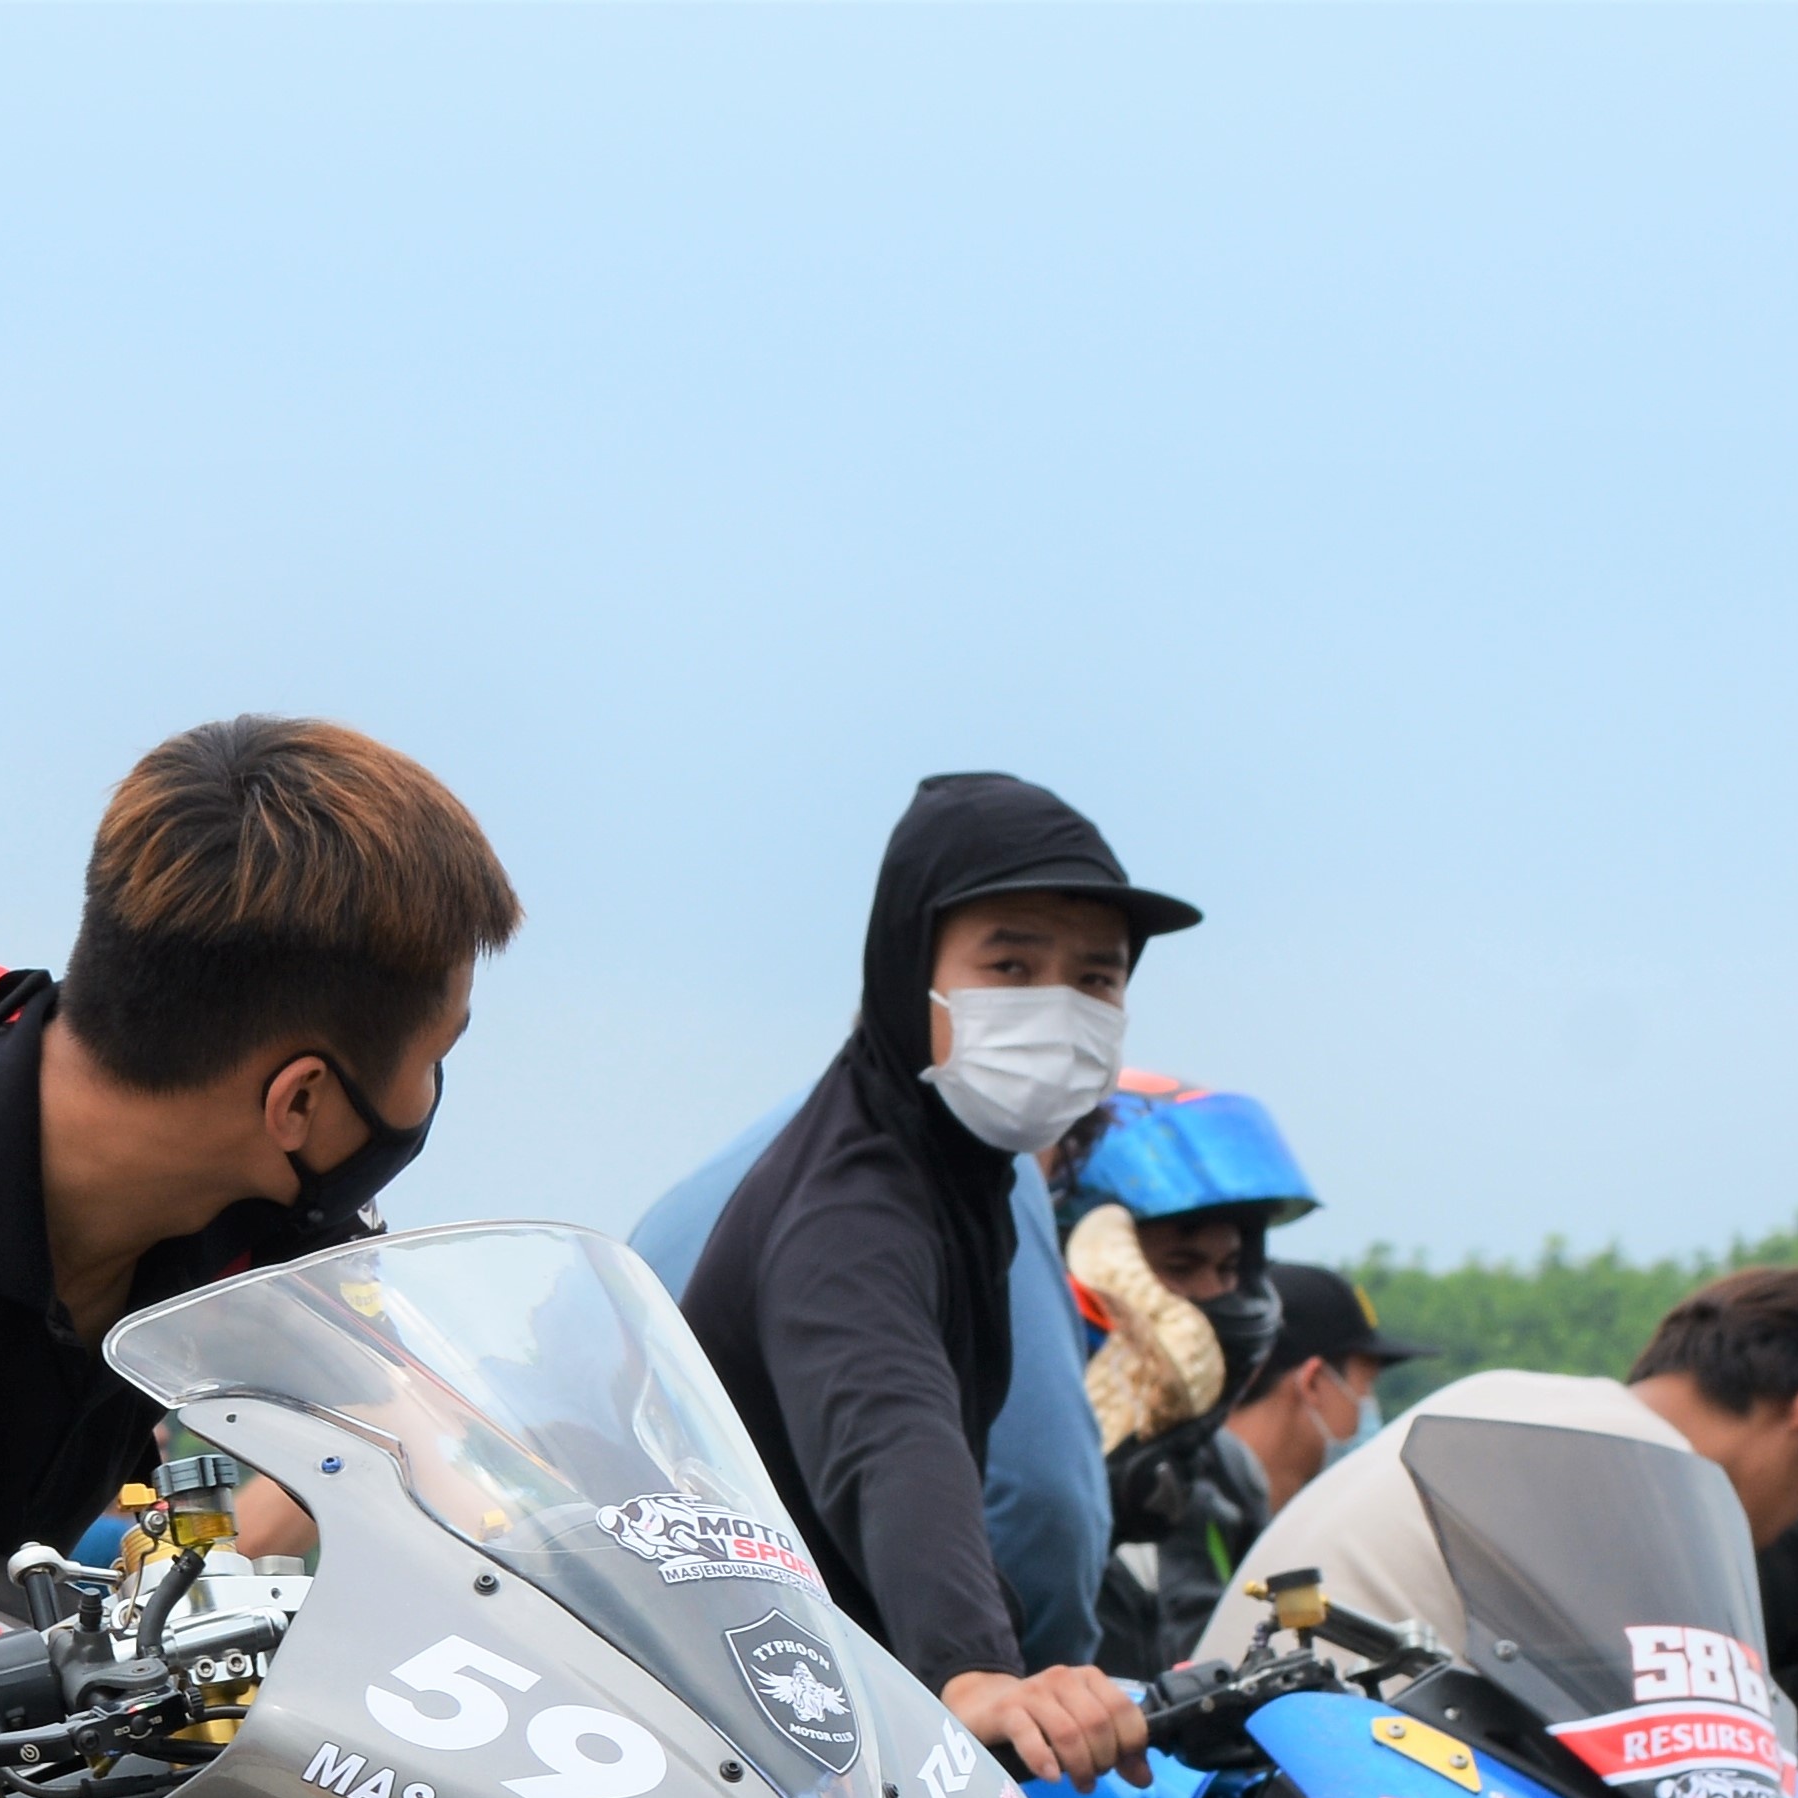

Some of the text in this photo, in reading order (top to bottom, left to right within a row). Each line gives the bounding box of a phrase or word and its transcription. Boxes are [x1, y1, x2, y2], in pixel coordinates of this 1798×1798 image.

[698, 1517, 794, 1552] MOTO
[752, 1638, 832, 1672] TYPHOON
[1624, 1625, 1771, 1718] 586
[788, 1721, 832, 1744] MOTOR
[1623, 1723, 1755, 1763] RESURS
